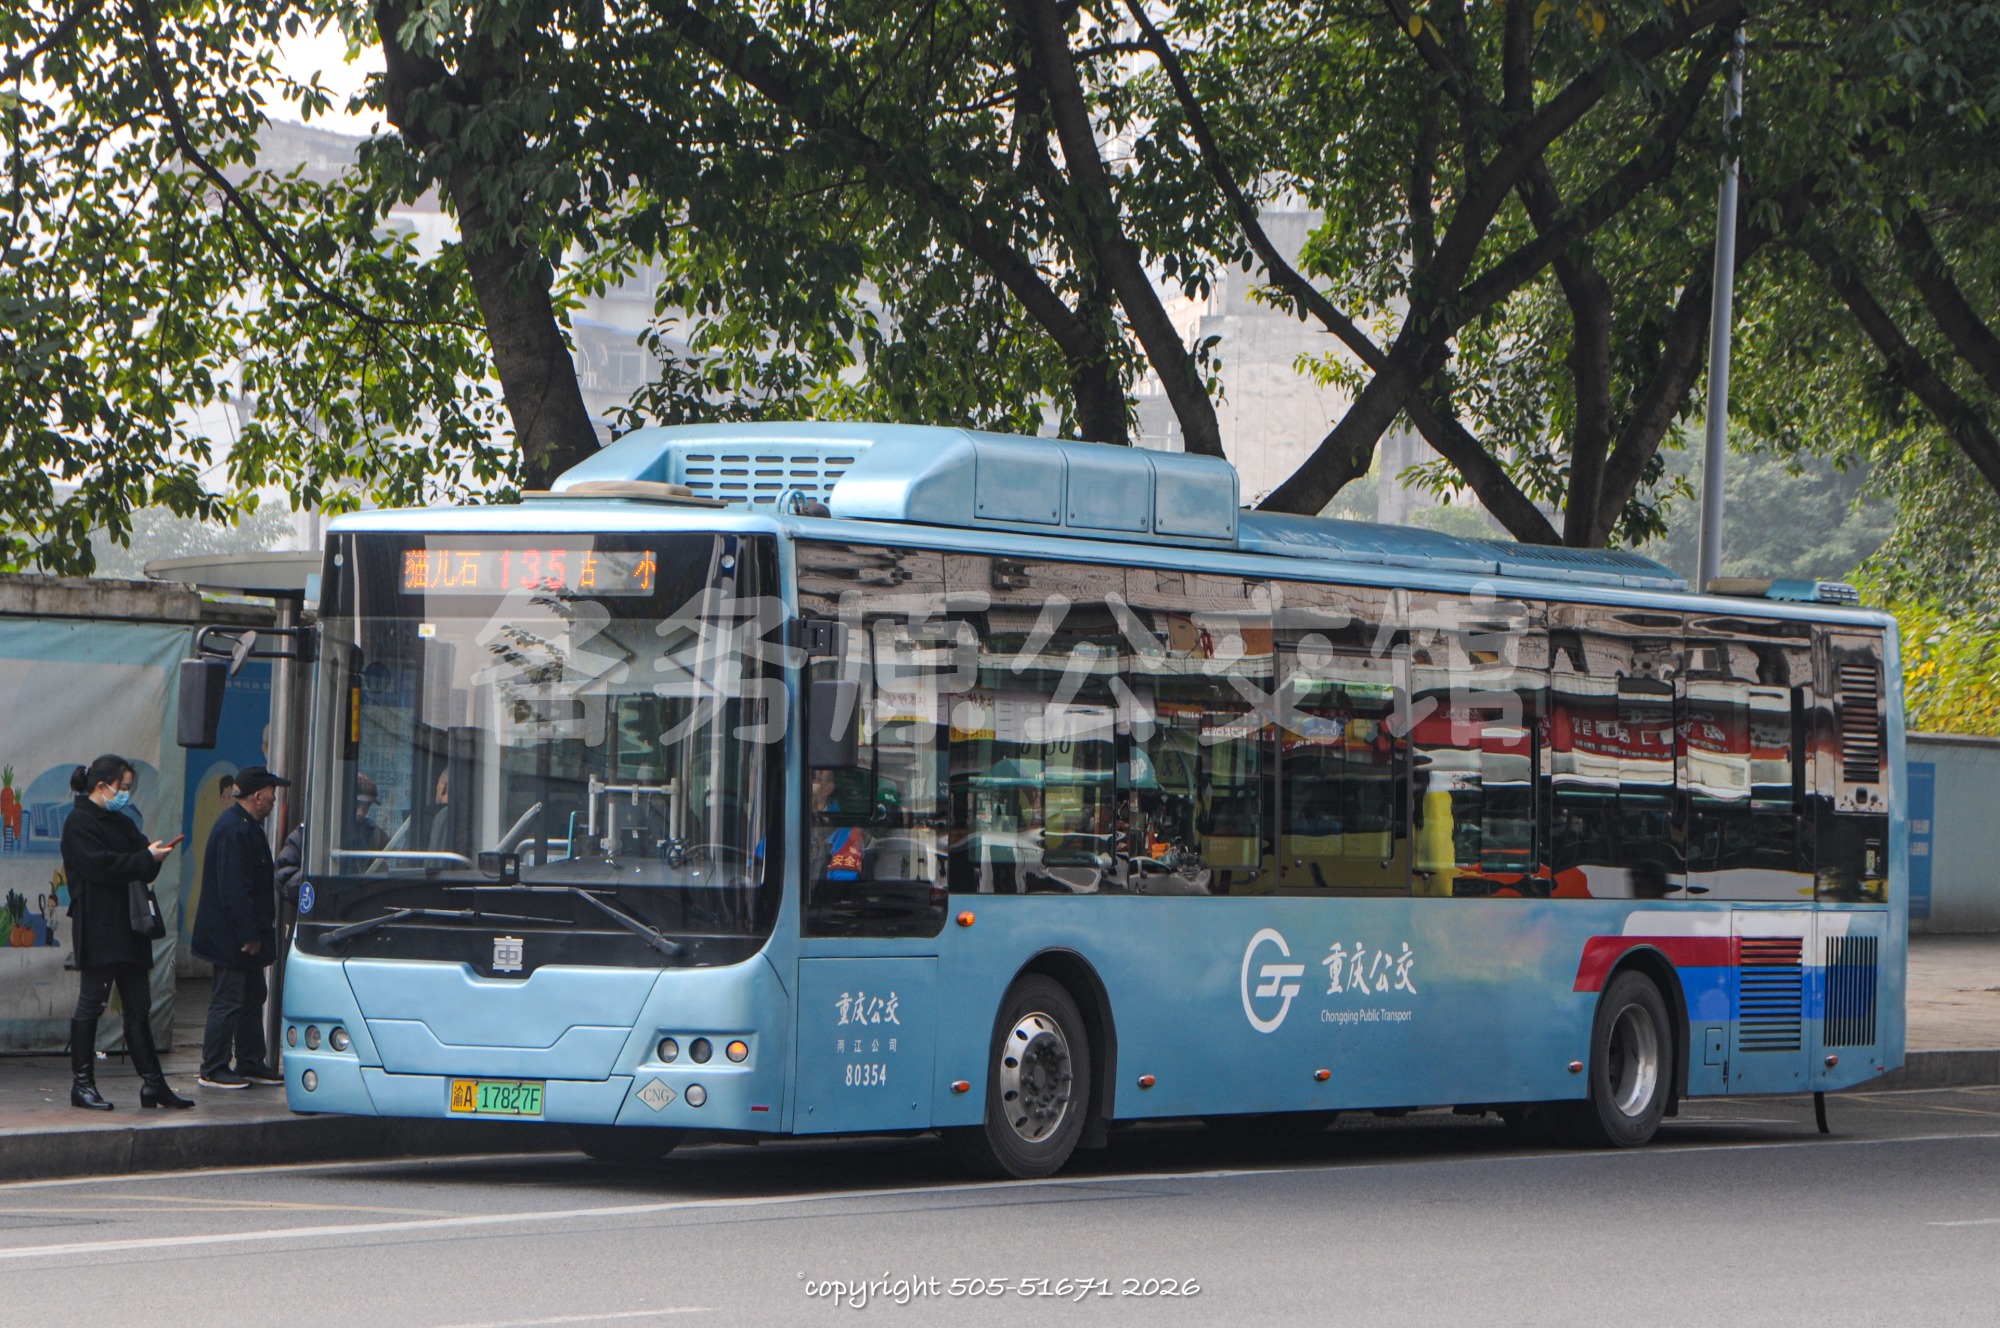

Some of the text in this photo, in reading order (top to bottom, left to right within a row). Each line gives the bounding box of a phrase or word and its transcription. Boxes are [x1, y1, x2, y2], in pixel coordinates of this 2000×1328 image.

[404, 549, 482, 588] 猫儿石
[501, 549, 567, 591] 135
[1321, 941, 1417, 995] 重庆公交
[834, 991, 901, 1026] 重庆公交
[1321, 1008, 1412, 1025] Chongqing Public Transport
[837, 1038, 898, 1053] 两江公司
[845, 1063, 887, 1086] 80354
[482, 1086, 541, 1110] 17827F
[643, 1089, 669, 1102] CNG
